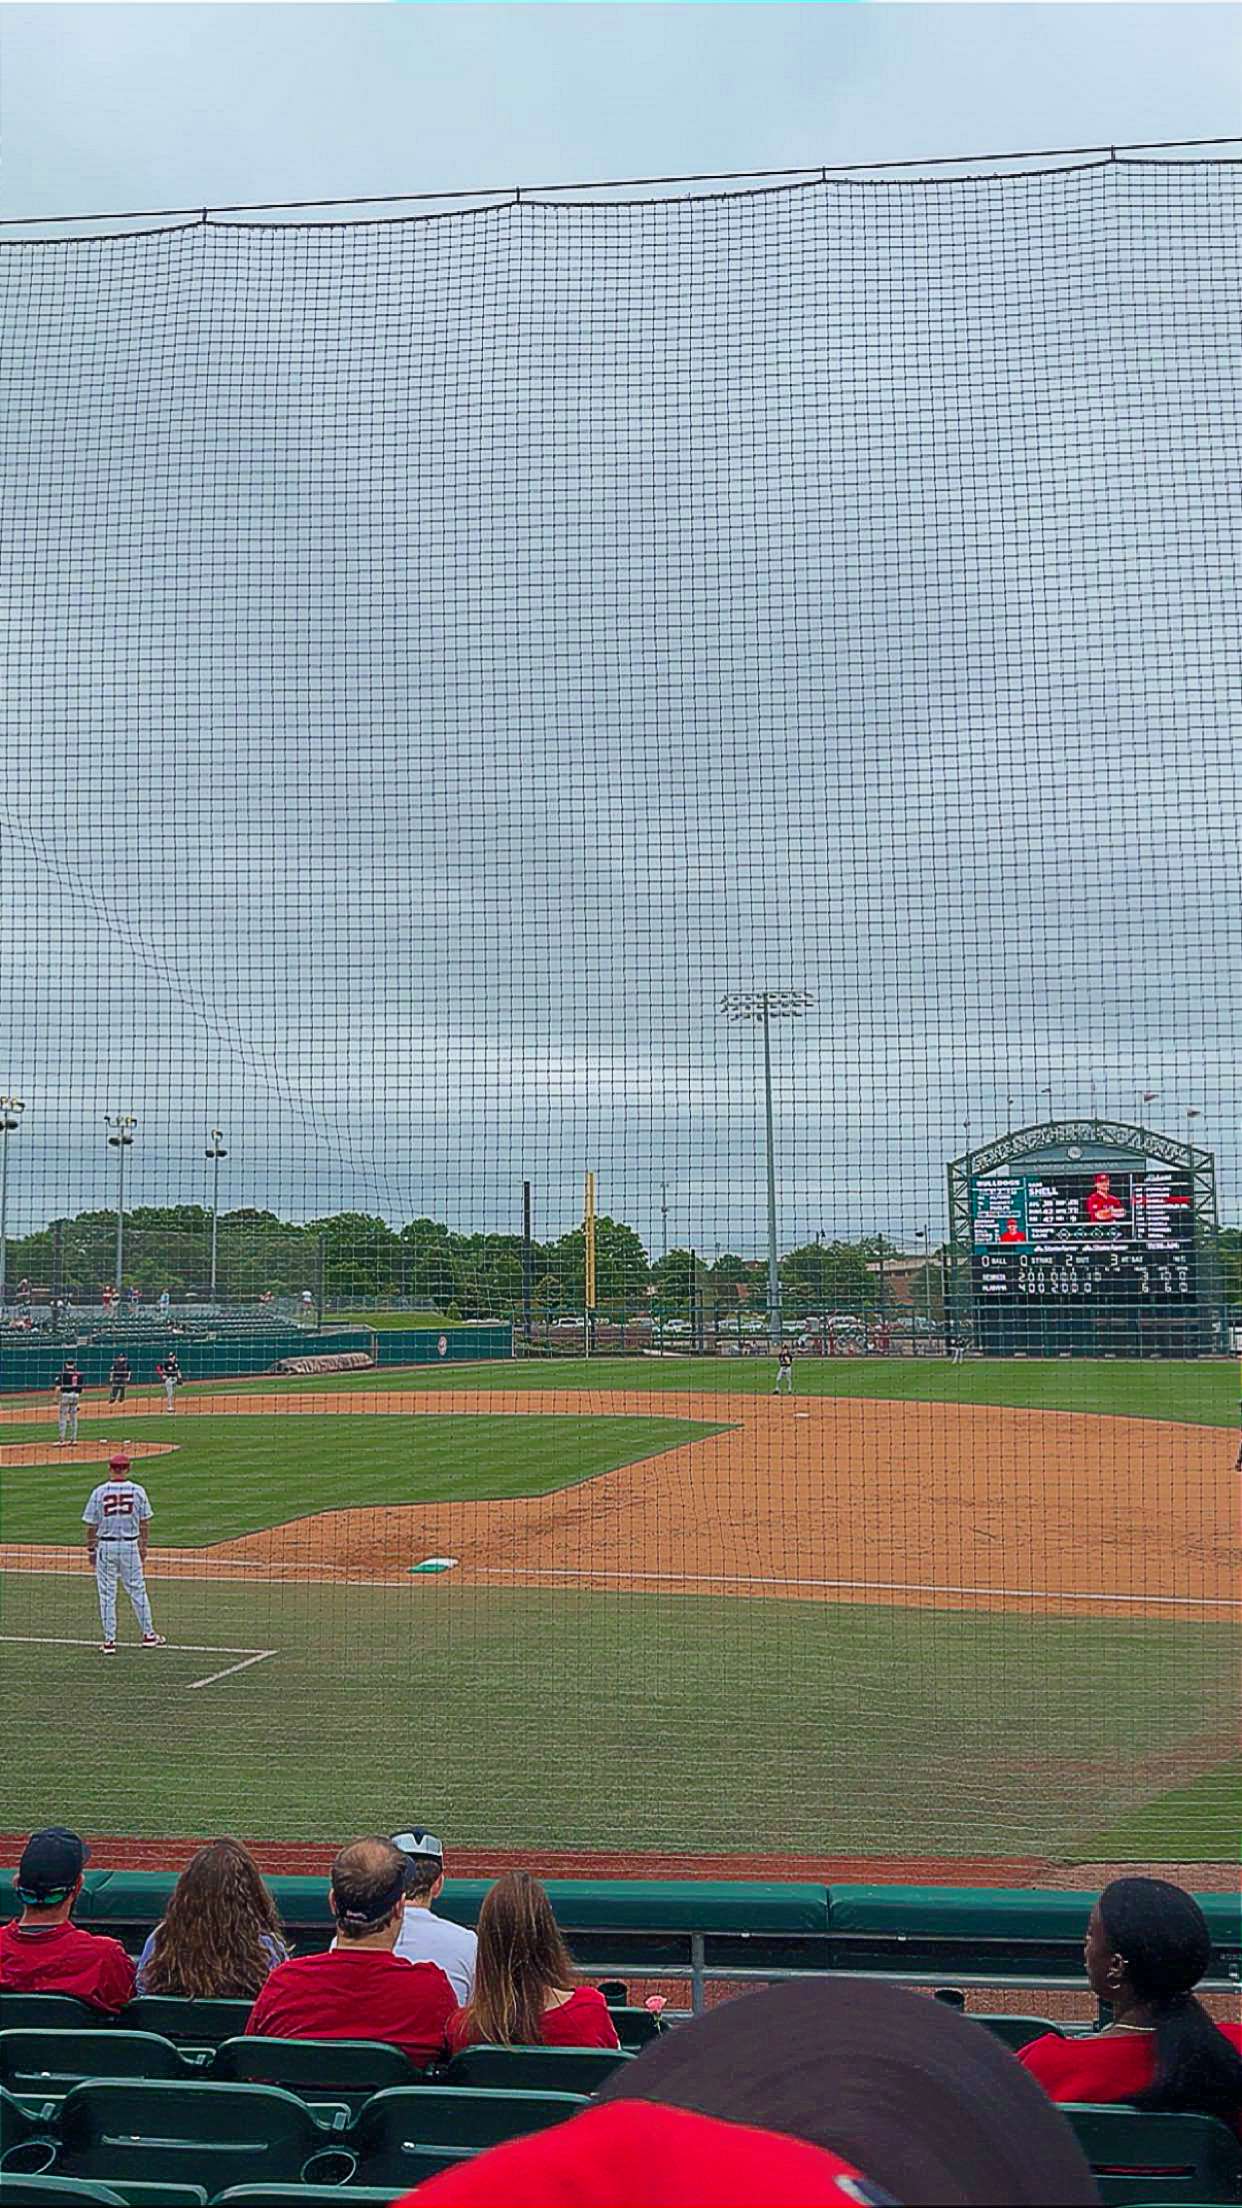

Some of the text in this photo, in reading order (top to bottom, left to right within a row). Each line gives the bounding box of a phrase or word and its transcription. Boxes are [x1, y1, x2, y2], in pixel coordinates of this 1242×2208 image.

[976, 1179, 1020, 1188] BULLDOGS
[981, 1255, 989, 1267] 0
[991, 1256, 1007, 1265] BALL
[1020, 1254, 1028, 1267] 0
[1031, 1256, 1053, 1264] STRIKE
[1065, 1254, 1073, 1267] 2
[1075, 1256, 1089, 1264] OUT
[1111, 1253, 1118, 1266] 3
[102, 1493, 135, 1517] 25
